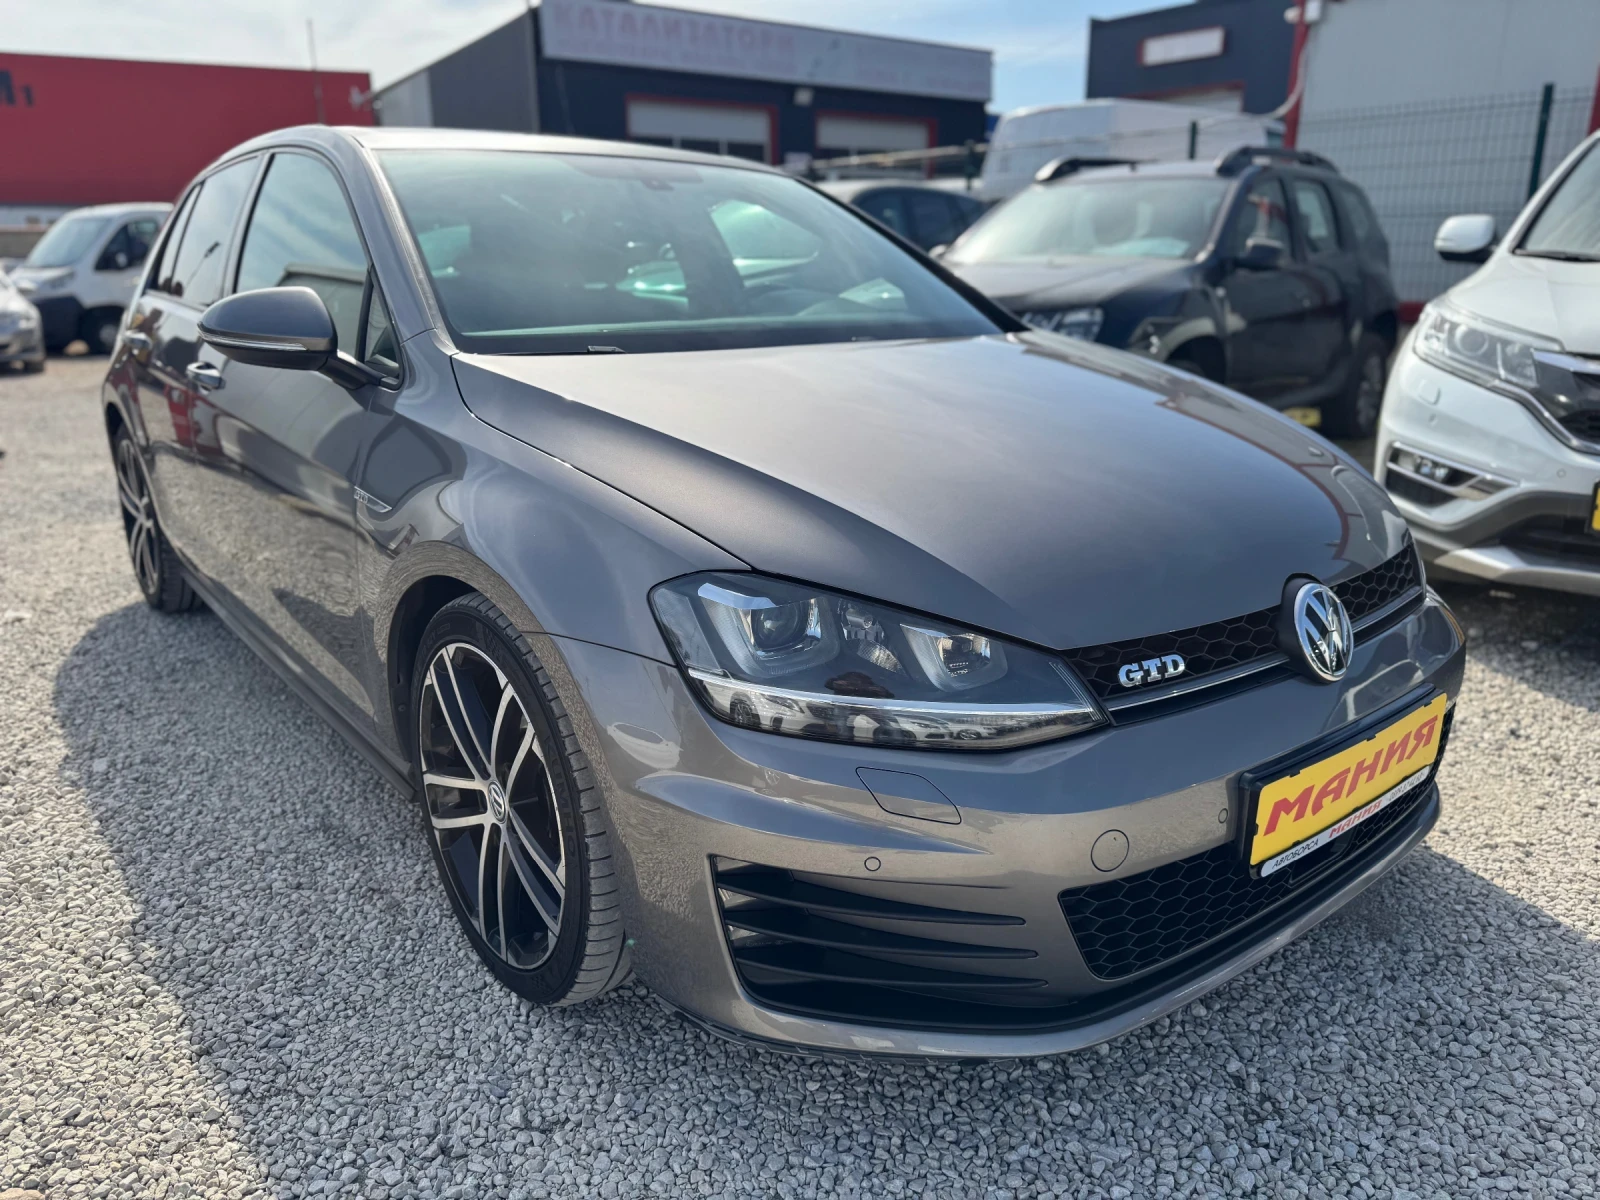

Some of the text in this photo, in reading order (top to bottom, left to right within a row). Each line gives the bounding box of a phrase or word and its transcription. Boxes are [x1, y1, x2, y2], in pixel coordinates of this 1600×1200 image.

[1117, 653, 1186, 688] GTD
[543, 735, 576, 858] KUMHO
[1262, 714, 1440, 837] МАНИЯ
[1271, 799, 1384, 870] АВТОБОРСА МАНИЯ
